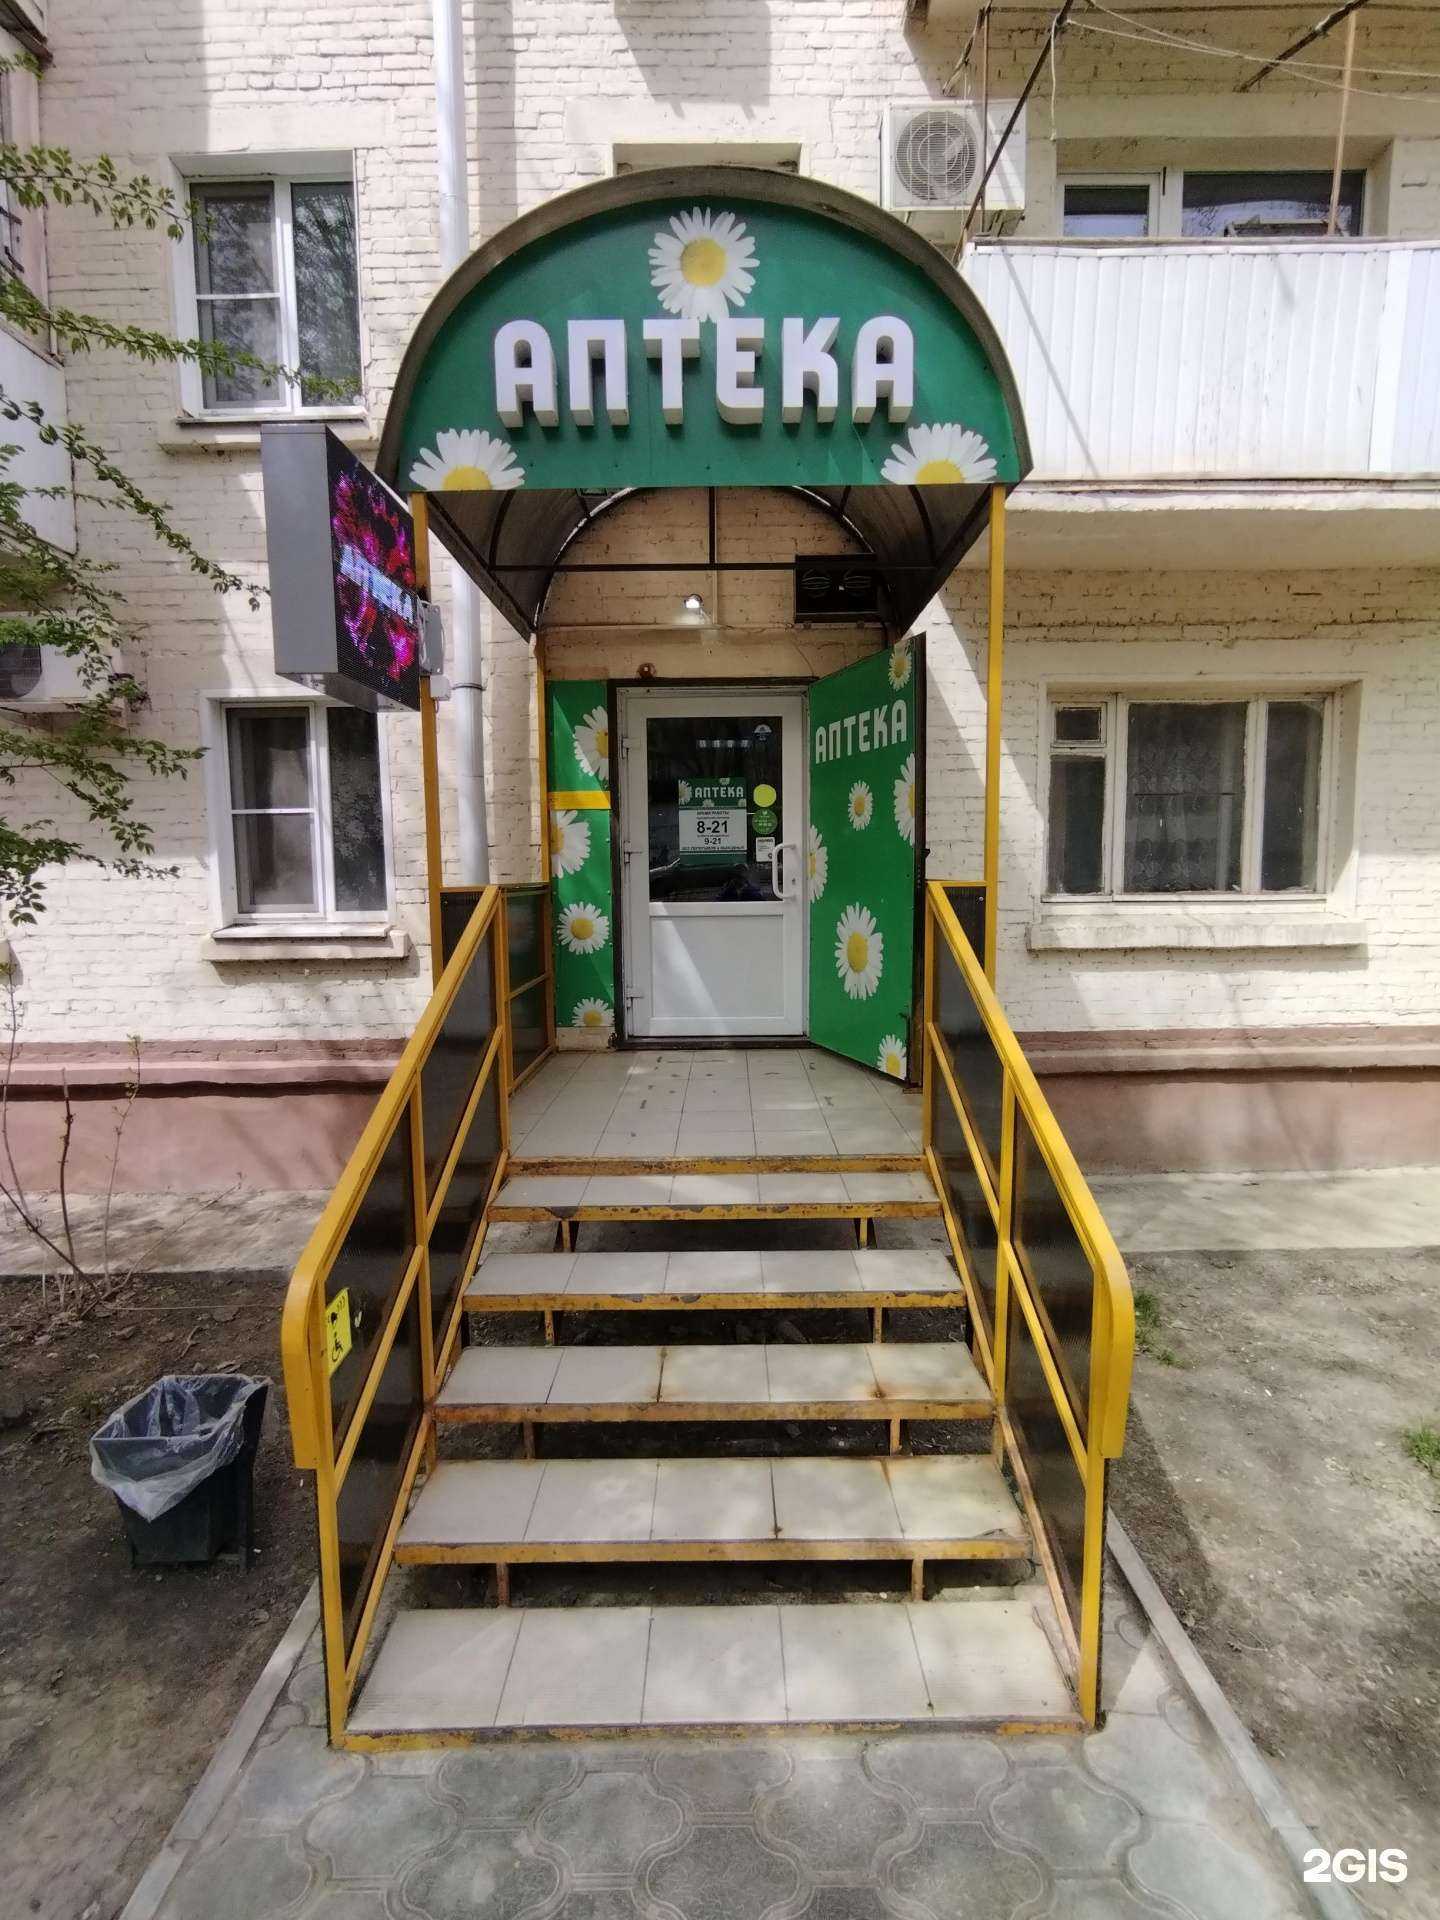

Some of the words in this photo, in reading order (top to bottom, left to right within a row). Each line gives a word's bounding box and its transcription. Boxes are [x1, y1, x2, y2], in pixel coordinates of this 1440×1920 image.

[494, 315, 914, 427] АПТЕКА
[815, 699, 907, 765] АПТЕКА
[694, 786, 744, 798] АПТЕКА
[696, 820, 728, 834] 8-21
